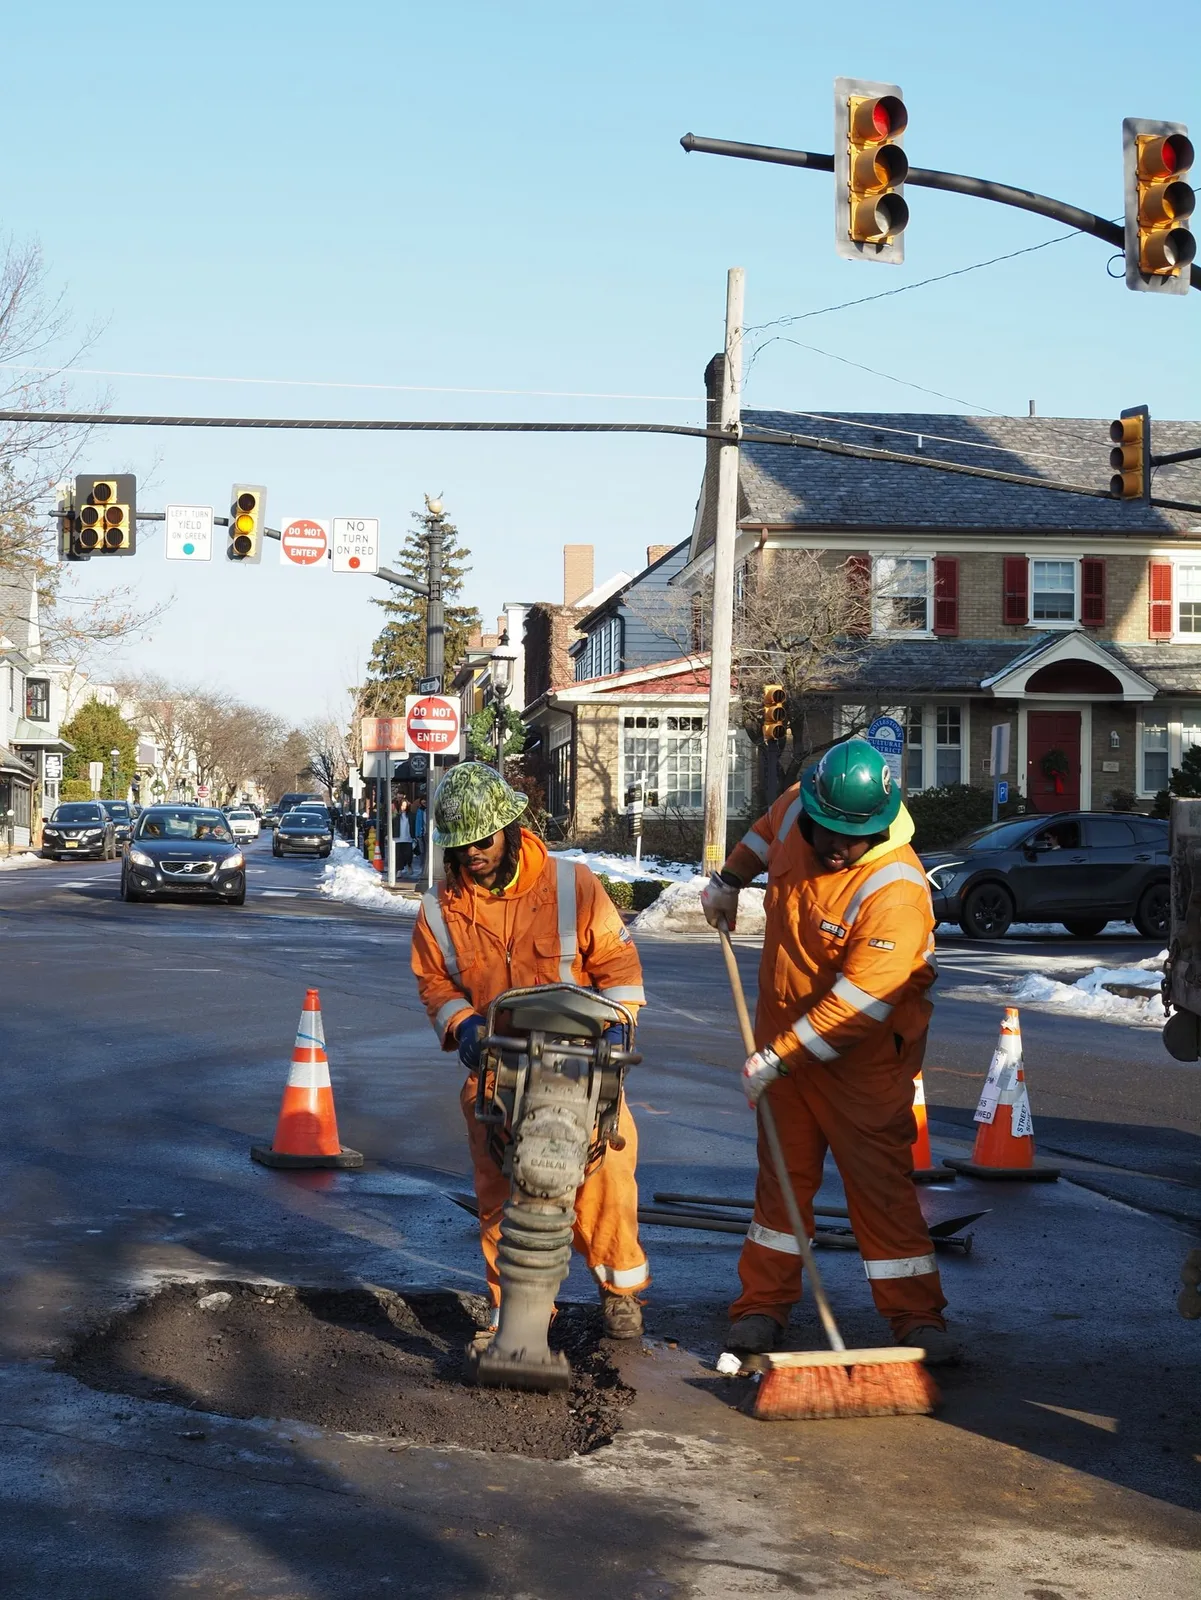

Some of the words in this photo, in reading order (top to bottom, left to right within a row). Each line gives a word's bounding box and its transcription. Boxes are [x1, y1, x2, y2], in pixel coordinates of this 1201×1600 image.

[192, 510, 209, 518] TURN
[178, 520, 202, 529] YIELD
[347, 521, 365, 532] NO
[185, 532, 207, 540] GREEN
[288, 527, 301, 535] DO
[304, 528, 322, 536] NOT
[343, 534, 369, 543] TURN
[290, 548, 318, 557] ENTER
[336, 545, 350, 554] ON
[354, 546, 374, 556] RED
[413, 707, 427, 716] DO
[432, 707, 452, 718] NOT
[368, 723, 406, 735] WRONG
[870, 719, 902, 738] DOYLESTOWN
[377, 735, 401, 745] WAY
[417, 732, 448, 743] ENTER
[868, 739, 902, 748] CULTURAL
[1017, 1104, 1027, 1133] STREET
